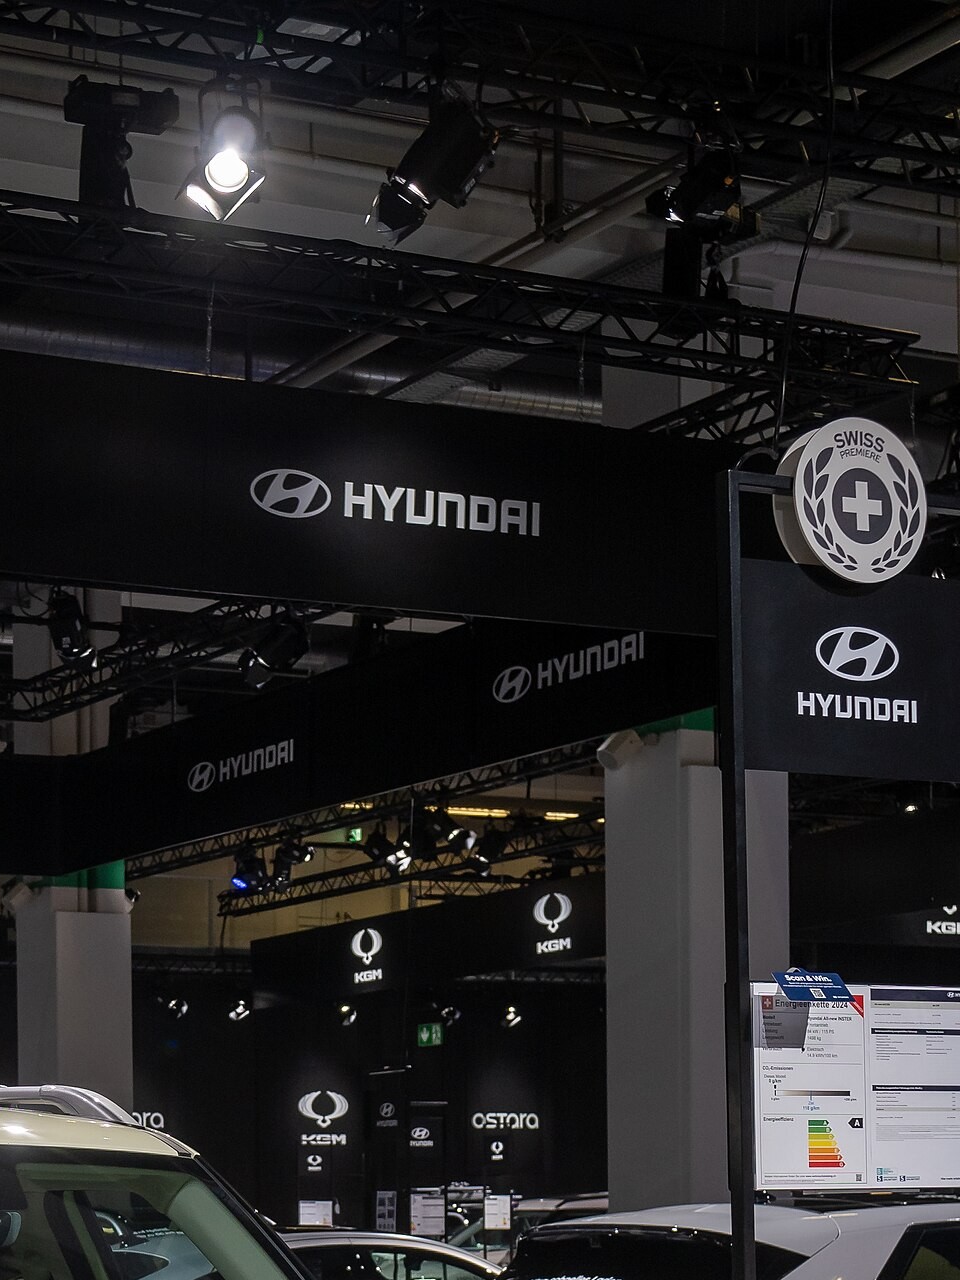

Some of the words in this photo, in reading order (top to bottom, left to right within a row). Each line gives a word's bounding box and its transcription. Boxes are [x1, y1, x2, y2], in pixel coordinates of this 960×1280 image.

[833, 430, 886, 453] SWISS
[839, 447, 882, 464] PREMIERE
[343, 481, 540, 537] HYUNDAI
[537, 631, 645, 690] HYUNDAI
[797, 691, 918, 724] HYUNDAI
[218, 739, 295, 783] HYUNDAI
[536, 937, 572, 955] KGM
[353, 968, 383, 984] KGM
[784, 974, 807, 982] Scan
[832, 1001, 848, 1009] 2024
[854, 1119, 861, 1127] A
[301, 1133, 347, 1145] KGM
